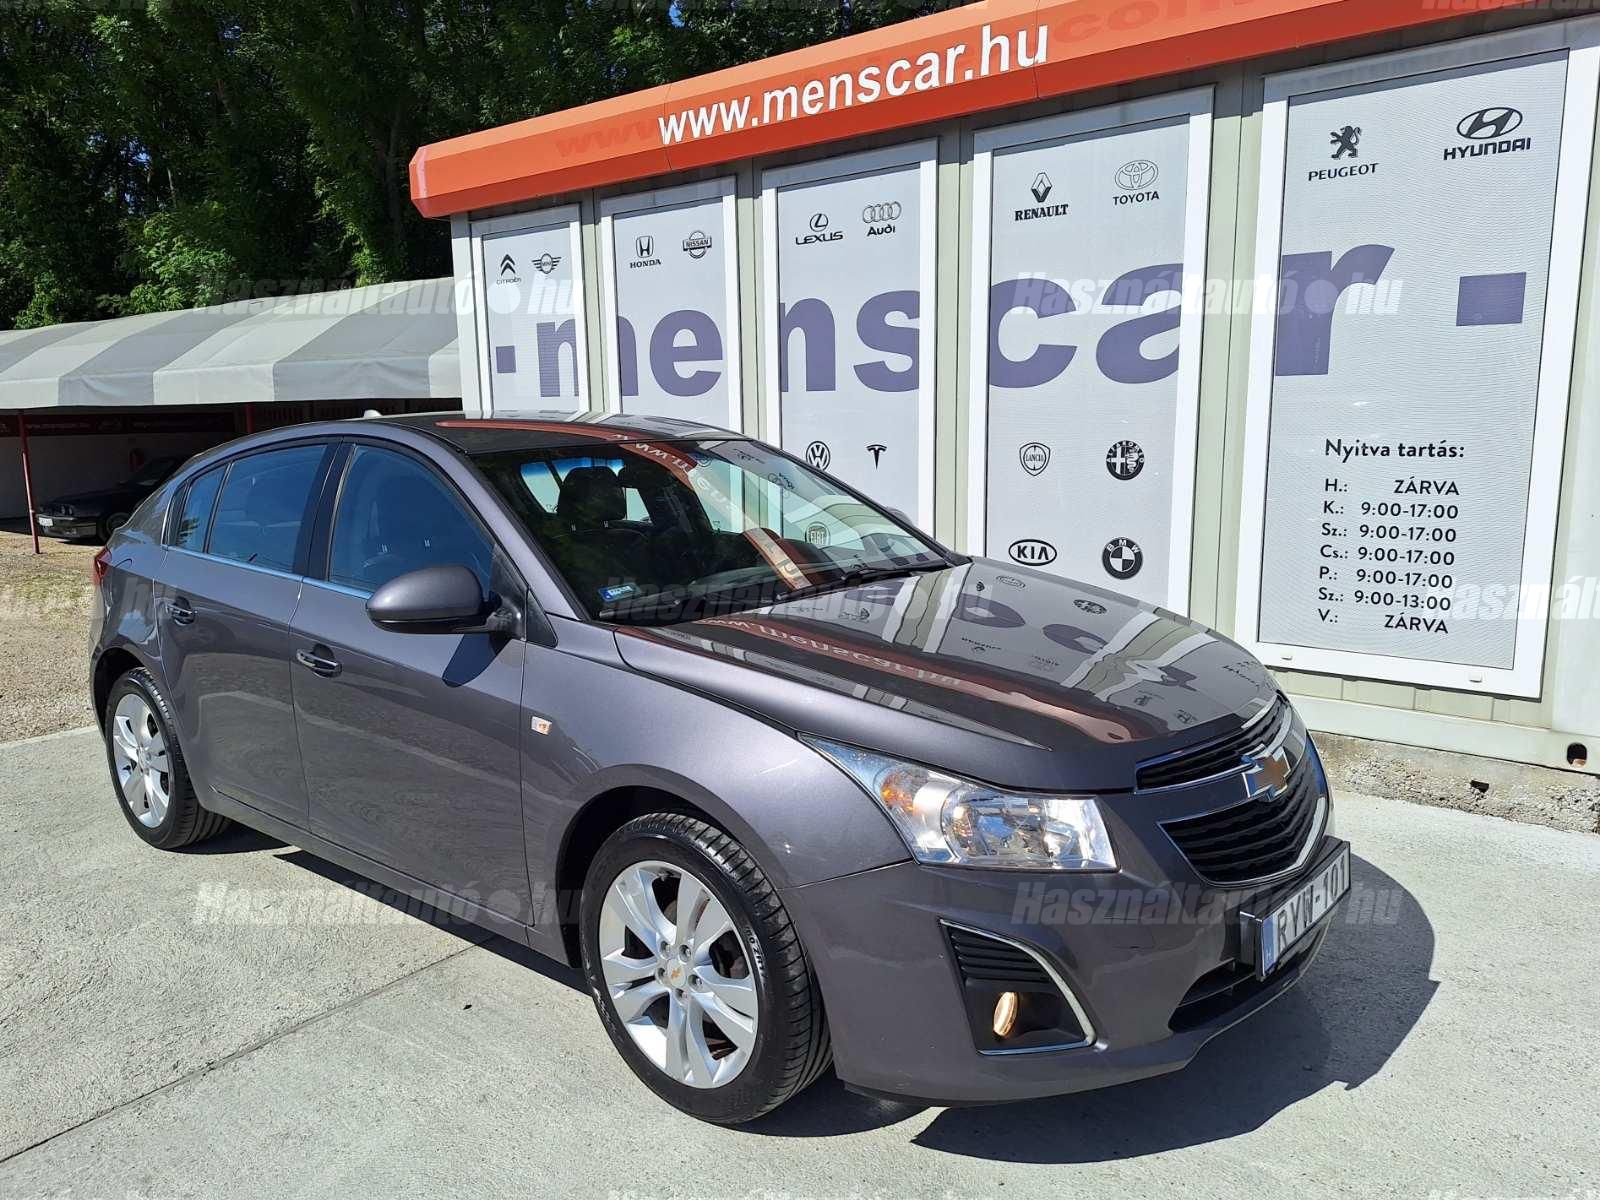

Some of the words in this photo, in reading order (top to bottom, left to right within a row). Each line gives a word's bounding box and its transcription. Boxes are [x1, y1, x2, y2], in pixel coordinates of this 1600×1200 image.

[658, 24, 1049, 145] www.menscar.hu
[1443, 138, 1531, 160] HYUNDAI
[1308, 163, 1379, 181] PEUGEOT
[1113, 191, 1160, 205] TOYOTA
[1015, 204, 1069, 221] RENAULT
[795, 231, 844, 245] LEXUS
[867, 224, 896, 237] Audi
[686, 239, 709, 248] NISSAN
[630, 259, 661, 269] HONDA
[1025, 453, 1045, 462] LANCIA
[1325, 438, 1391, 463] Nyitva
[1398, 440, 1465, 458] tartás:
[1325, 478, 1348, 492] H.:
[1394, 476, 1460, 496] ZÁRVA
[1323, 500, 1344, 514] K.:
[1361, 501, 1459, 519] 9:00-17:00
[1321, 522, 1347, 536] Sz.:
[1359, 524, 1456, 542] 9:00-17:00
[1017, 545, 1050, 561] KIA
[1320, 544, 1348, 559] Cs.:
[1358, 546, 1455, 565] 9:00-17:00
[1319, 566, 1337, 580] P.:
[1356, 568, 1453, 588] 9:00-17:00
[1318, 587, 1344, 602] Sz.:
[1354, 589, 1451, 611] 9:00-13:00
[1318, 608, 1338, 623] V.:
[1384, 612, 1449, 634] ZÁRVA
[1277, 855, 1345, 953] RYW-101
